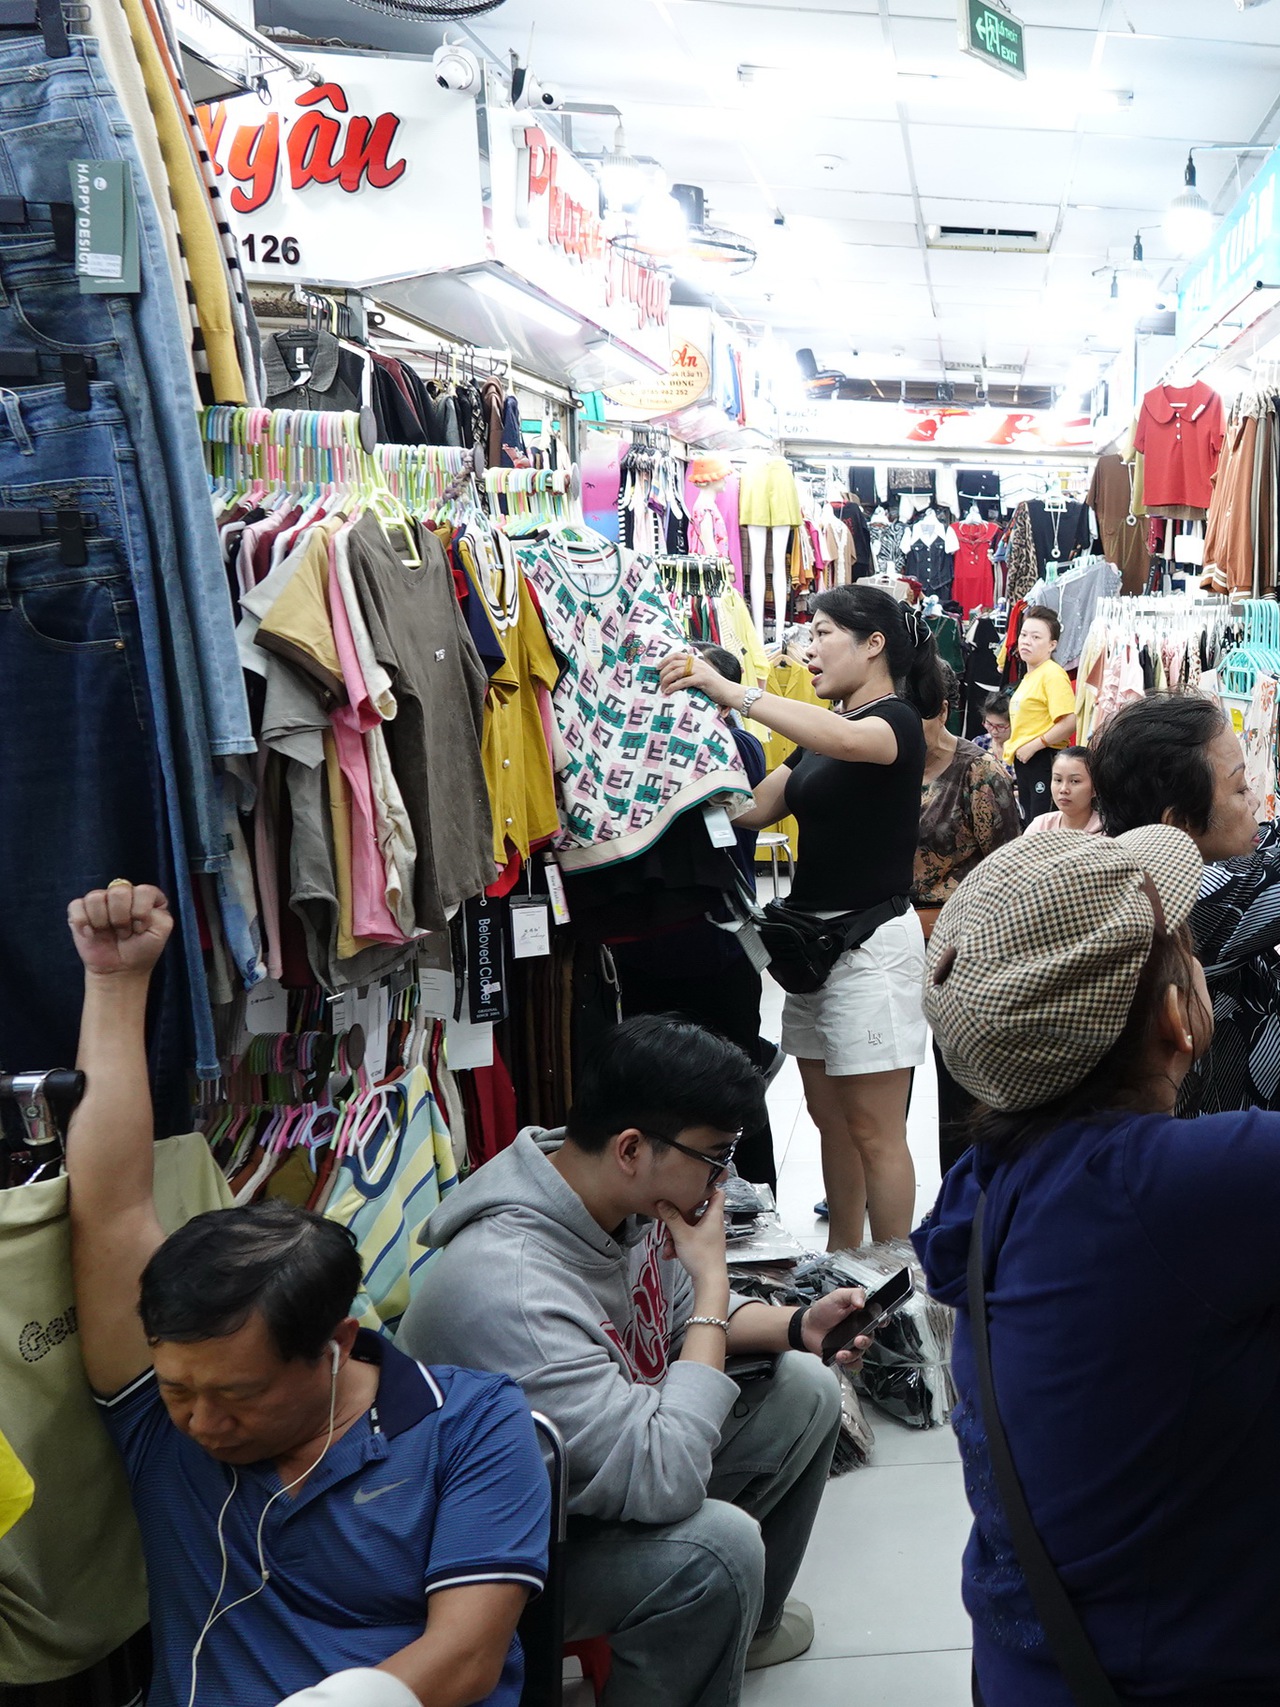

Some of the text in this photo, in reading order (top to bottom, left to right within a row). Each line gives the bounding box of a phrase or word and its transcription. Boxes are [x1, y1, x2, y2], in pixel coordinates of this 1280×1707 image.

[1001, 44, 1018, 65] EXIT
[77, 163, 91, 215] HAPPY
[241, 233, 300, 265] 126
[478, 917, 492, 965] Beloved
